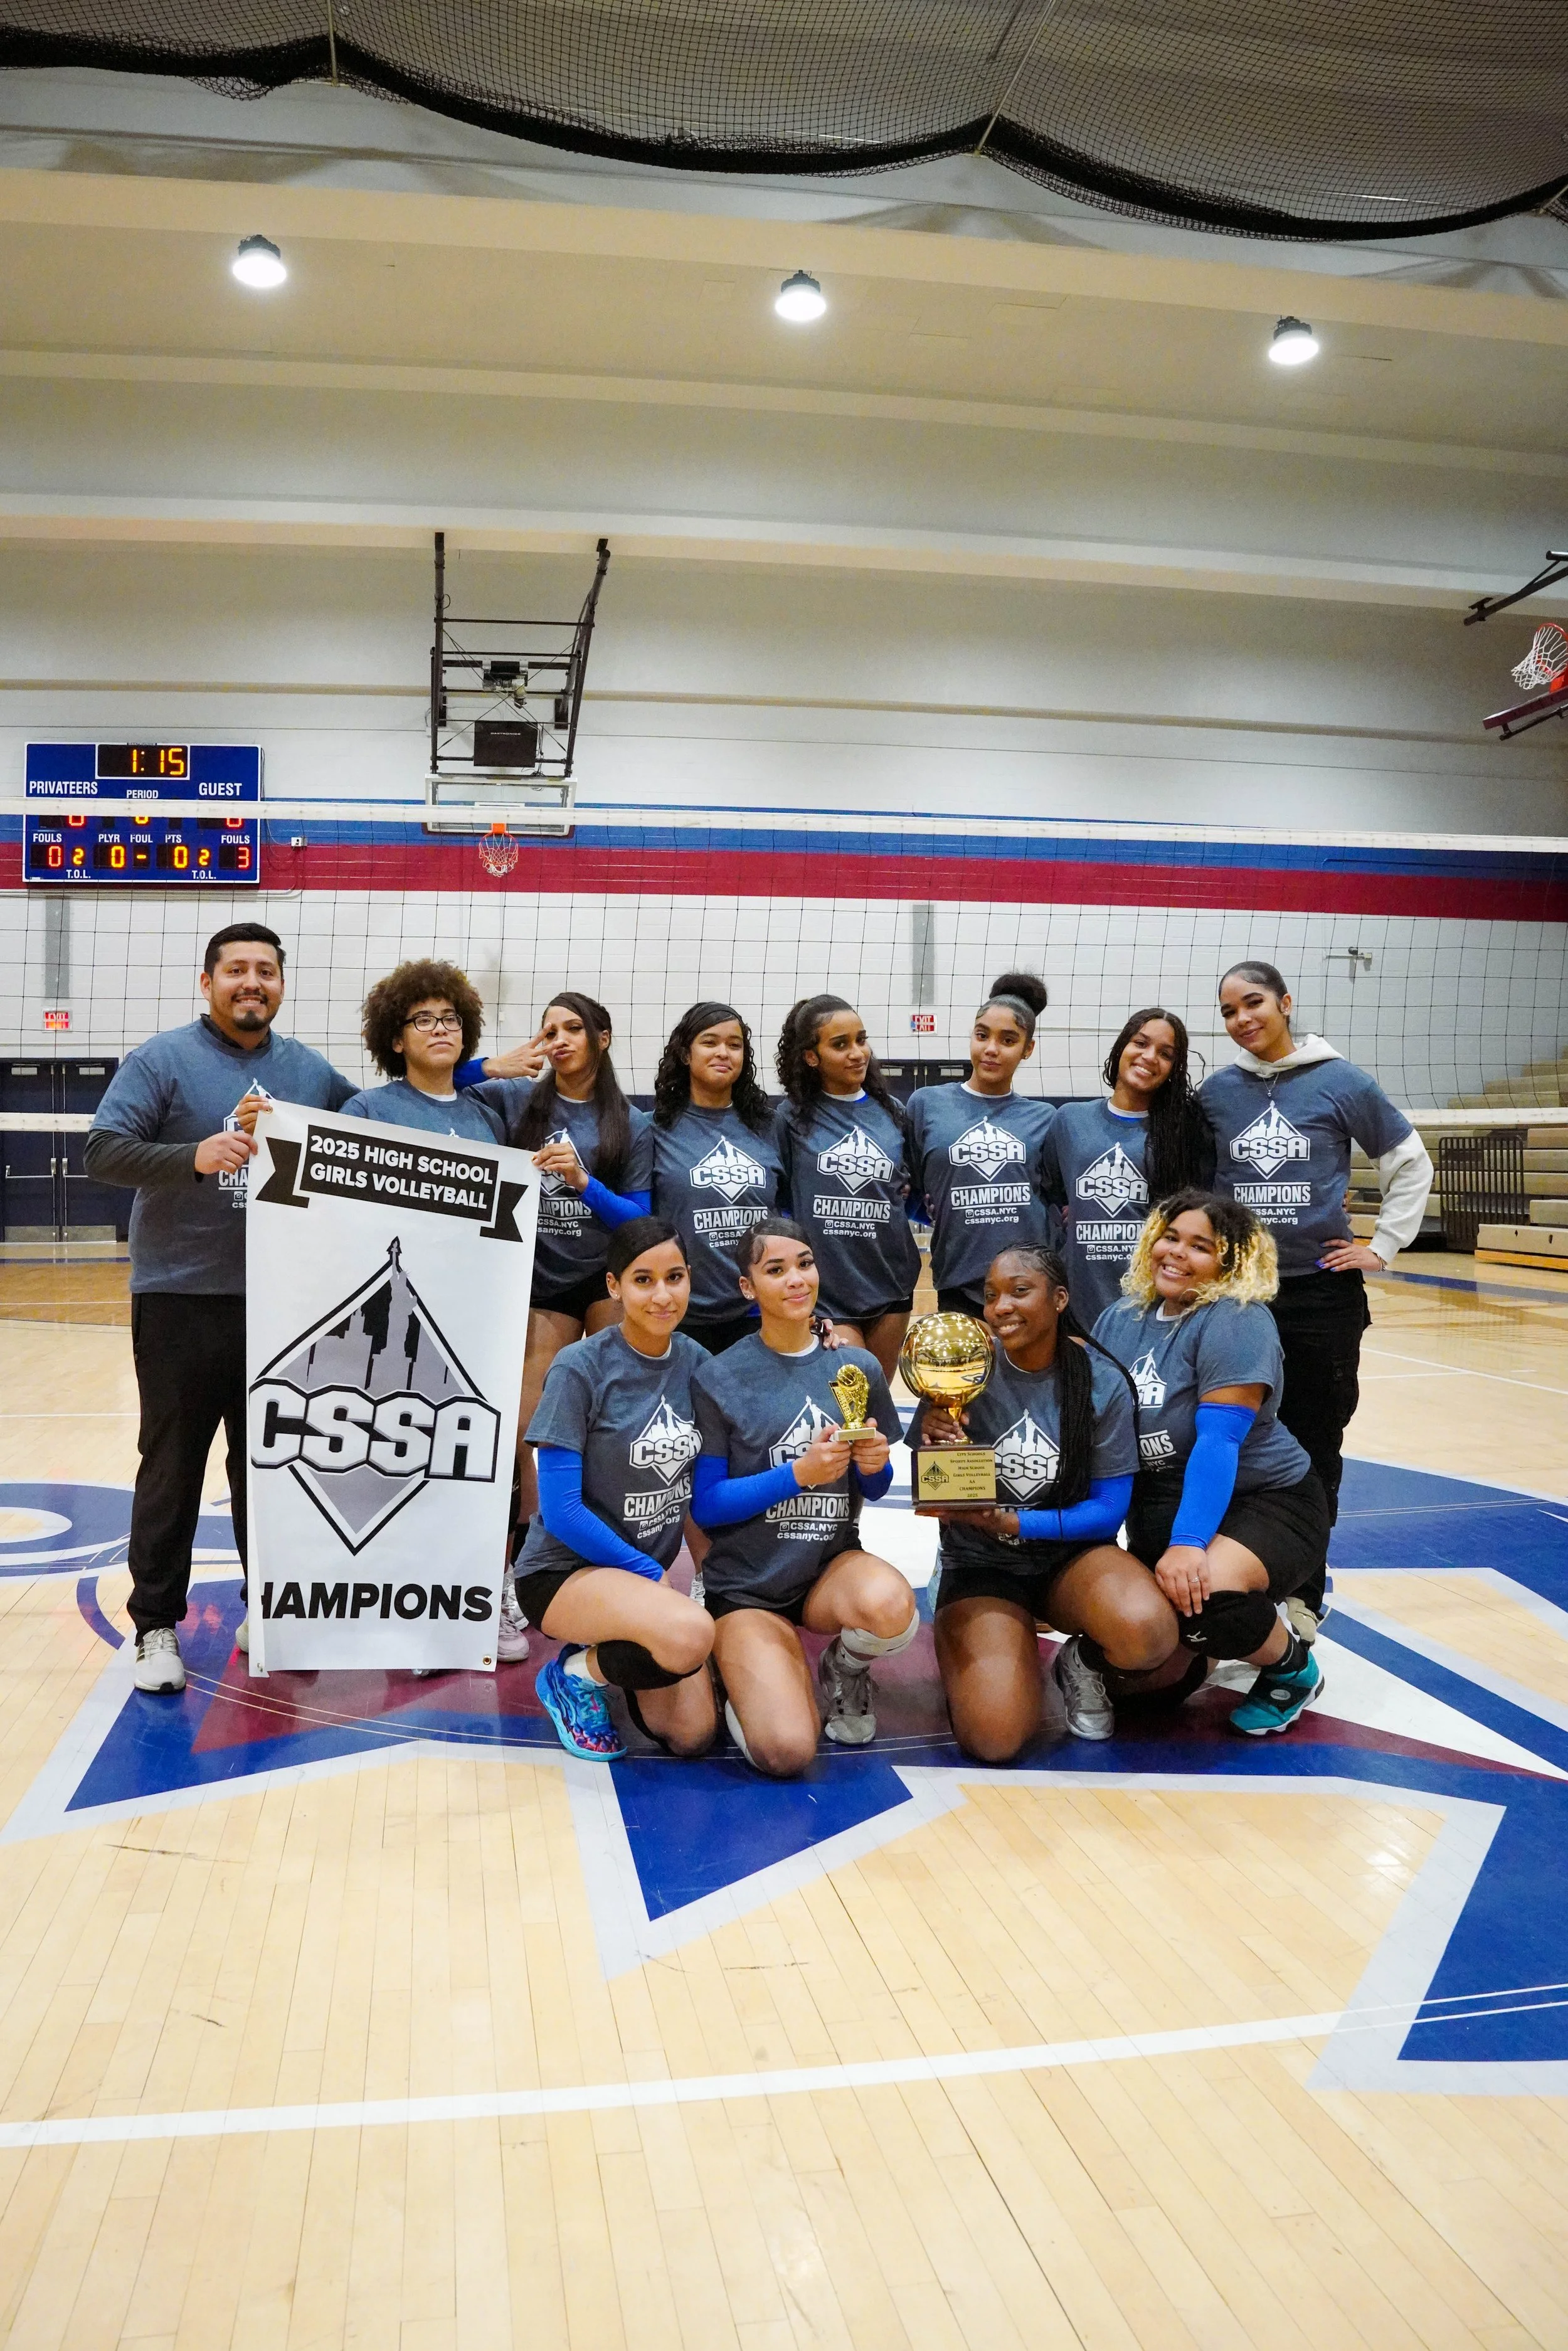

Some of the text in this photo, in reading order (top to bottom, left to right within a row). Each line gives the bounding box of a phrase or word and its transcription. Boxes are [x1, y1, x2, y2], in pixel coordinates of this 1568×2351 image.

[132, 748, 184, 775] 1:15
[29, 781, 98, 795] PRIVATEERS
[126, 789, 159, 799] PERIOD
[199, 782, 242, 796] GUEST
[33, 834, 62, 843] FOULS
[98, 834, 120, 843] PLYR
[130, 834, 153, 844] FOUL
[165, 834, 182, 844] PTS
[221, 835, 250, 844] FOULS
[48, 846, 61, 868] 0
[238, 847, 249, 869] 3
[66, 869, 91, 879] T.O.L.
[192, 870, 216, 879] T.O.L.
[950, 1141, 1025, 1165] CSSA
[1231, 1137, 1310, 1161] CSSA
[310, 1135, 494, 1185] 2025 HIGH SCHOOL
[818, 1152, 893, 1182] CSSA
[691, 1164, 765, 1187] CSSA
[310, 1162, 488, 1209] GIRLS VOLLEYBALL
[1076, 1176, 1148, 1202] CSSA
[951, 1186, 1030, 1206] CHAMPIONS
[1234, 1186, 1311, 1203] CHAMPIONS
[813, 1198, 891, 1219] CHAMPIONS
[974, 1207, 1017, 1216] CSSA.NYC
[538, 1219, 578, 1228] CSSA.NYC
[694, 1209, 768, 1229] CHAMPIONS
[834, 1221, 875, 1229] CSSA.NYC
[965, 1216, 1019, 1224] cssanyc.org
[538, 1227, 581, 1236] sanyc.org
[823, 1229, 877, 1239] cssanyc.org
[1076, 1224, 1145, 1241] CHAMPION
[709, 1239, 740, 1248] cssany
[249, 1378, 501, 1482] CSSA
[630, 1430, 702, 1467] CSSA
[921, 1475, 949, 1483] CSSA
[766, 1497, 849, 1519] CHAMPIONS
[790, 1522, 837, 1532] CSSA.NYC
